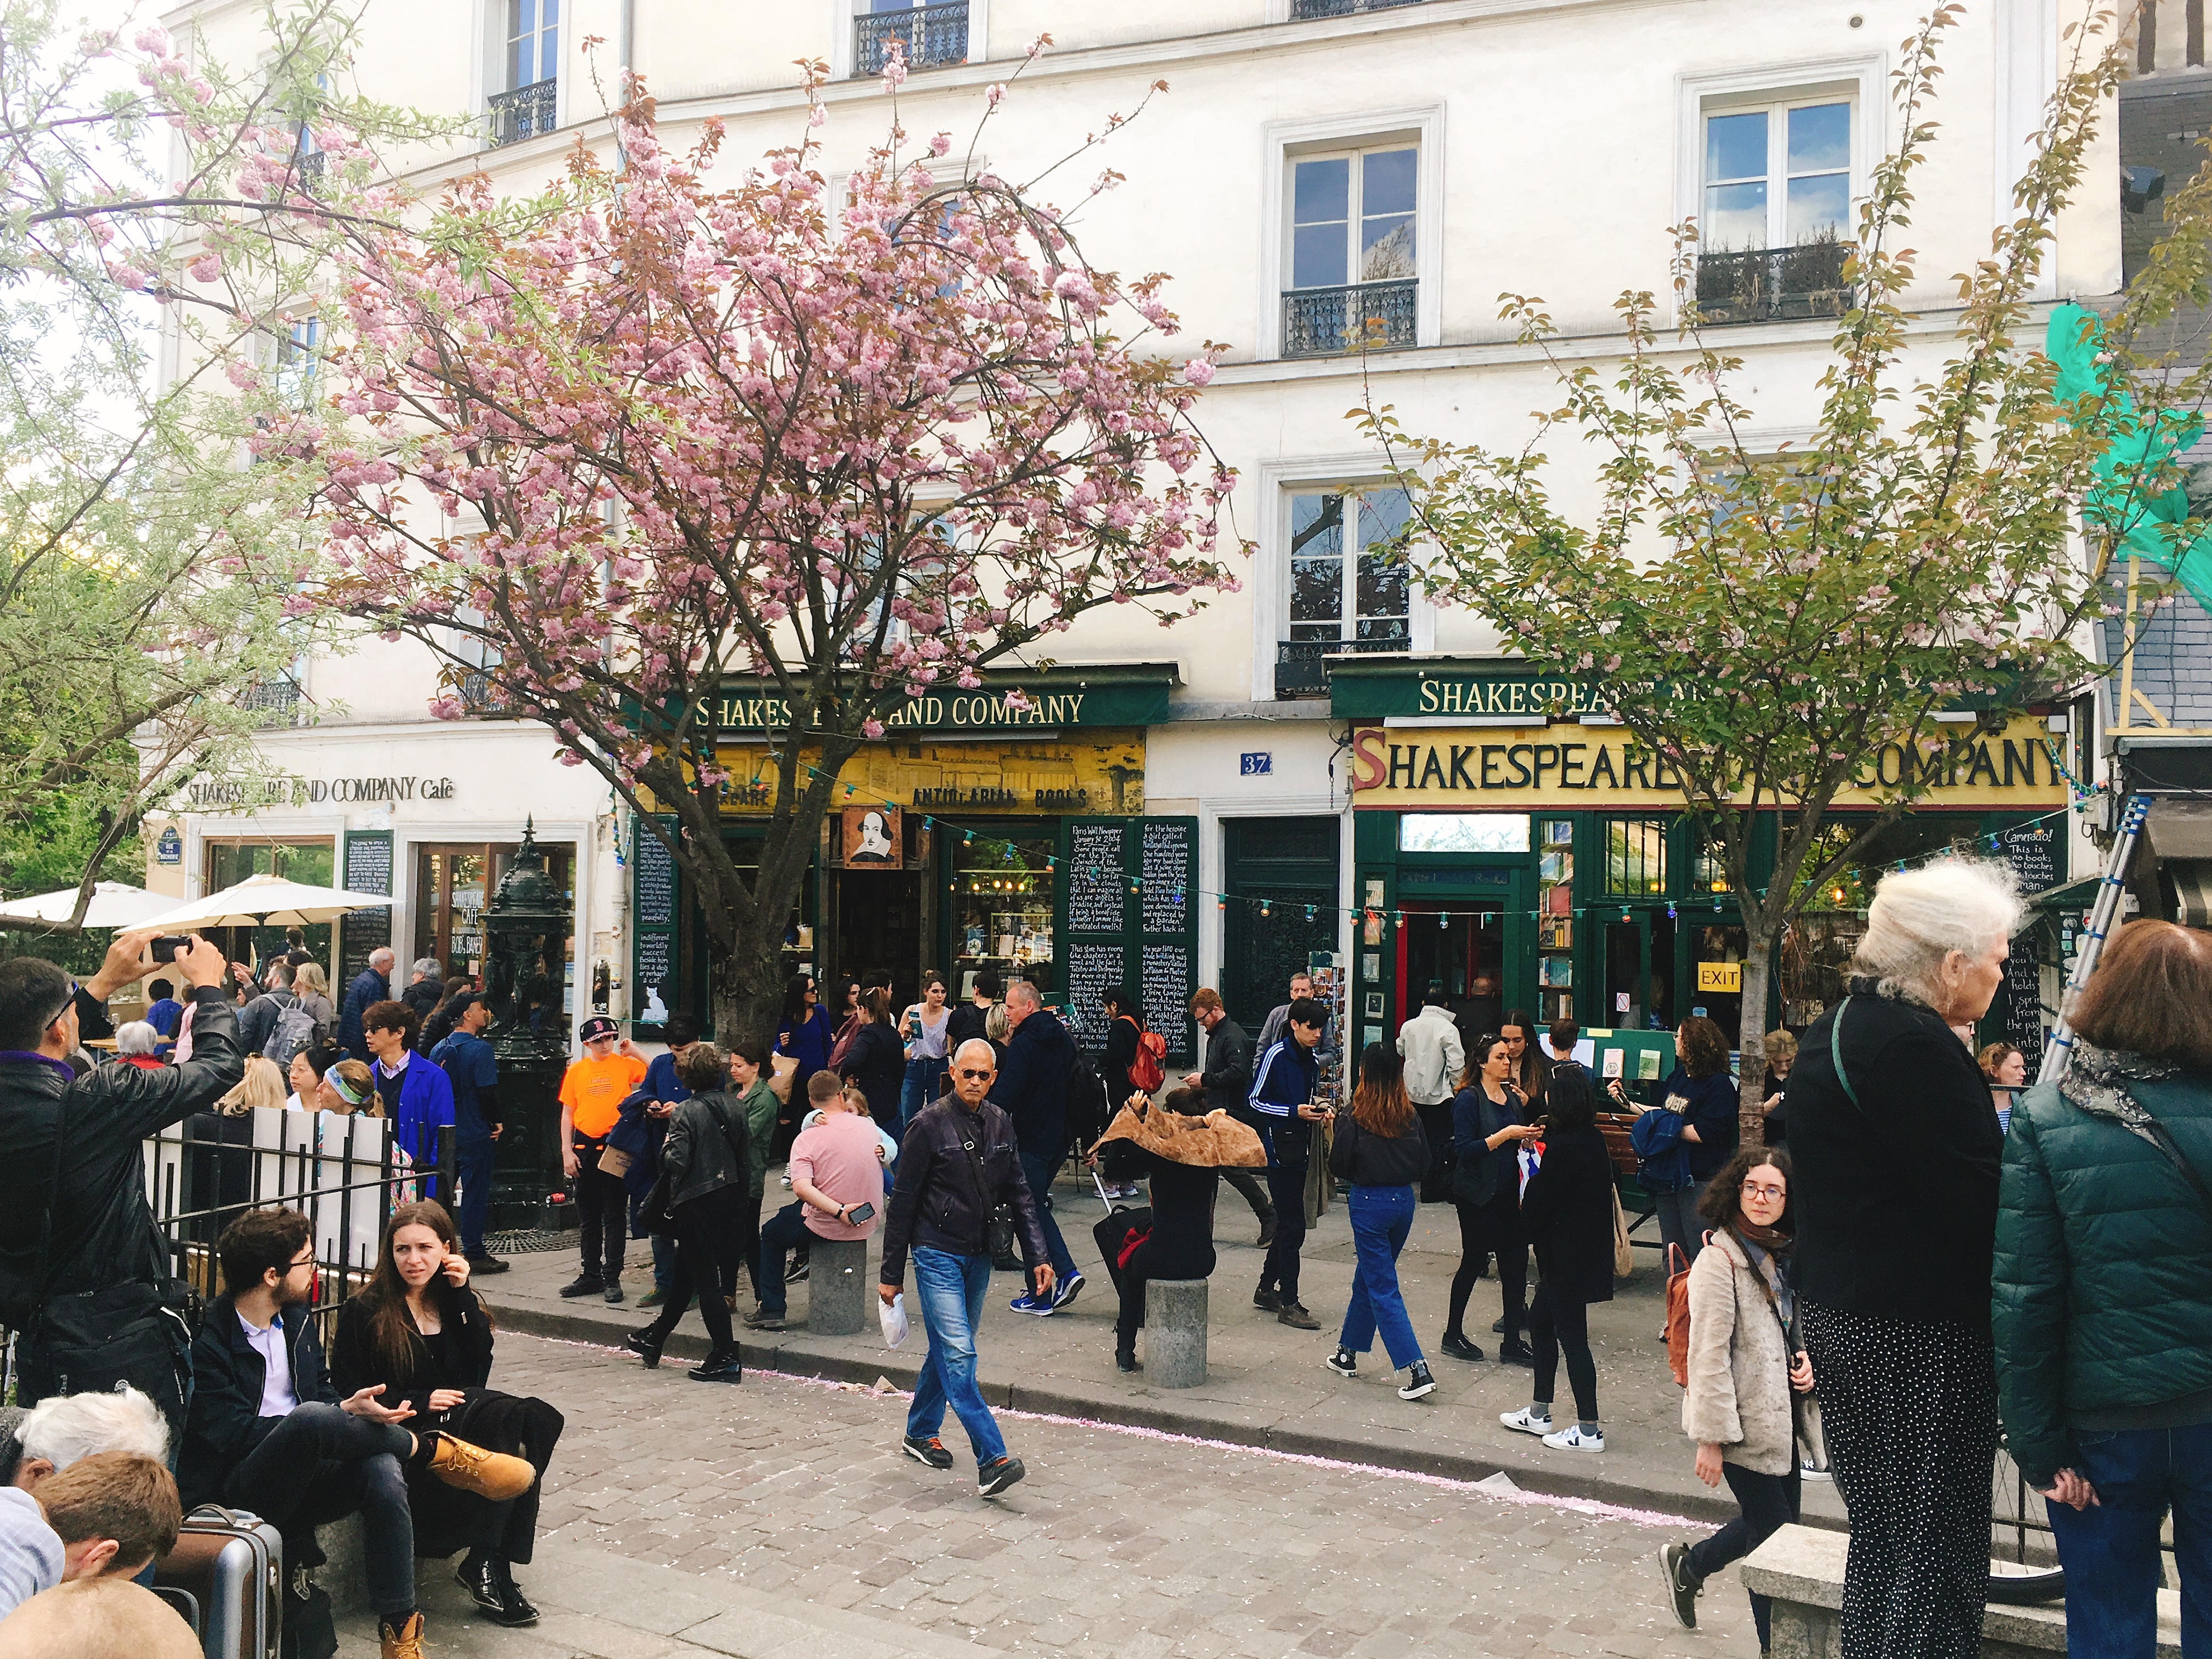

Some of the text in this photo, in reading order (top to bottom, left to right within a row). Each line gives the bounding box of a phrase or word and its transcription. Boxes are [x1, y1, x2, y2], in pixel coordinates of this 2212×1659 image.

[1420, 680, 1654, 713] SHAKESPEA
[696, 696, 877, 726] SHAKESE
[888, 697, 943, 725] AND
[1245, 755, 1267, 773] 37
[1353, 729, 1680, 792] SHAKESPEARE
[332, 777, 417, 802] COMPANY
[420, 777, 454, 800] Café
[1073, 826, 1086, 835] Paris
[1103, 835, 1121, 844] 2004
[2008, 845, 2043, 854] This is
[1072, 857, 1097, 865] Quixote
[2025, 854, 2051, 862] book;
[2024, 861, 2053, 871] touches
[2025, 871, 2053, 881] touches
[642, 913, 670, 923] peacefully.
[1153, 910, 1176, 918] replaced
[1178, 911, 1185, 921] by
[1073, 922, 1100, 931] frustrated
[1143, 924, 1161, 933] Further
[641, 933, 669, 942] indifferent
[1070, 944, 1083, 952] This
[2008, 958, 2026, 967] you
[657, 964, 669, 974] dog
[1069, 966, 1088, 974] Tolstoy
[2007, 967, 2028, 978] And
[1702, 970, 1739, 985] EXIT
[2012, 979, 2035, 990] holds
[2008, 994, 2012, 1006] I
[2015, 1006, 2040, 1020] from
[2007, 1019, 2022, 1030] the
[2016, 1036, 2040, 1048] into
